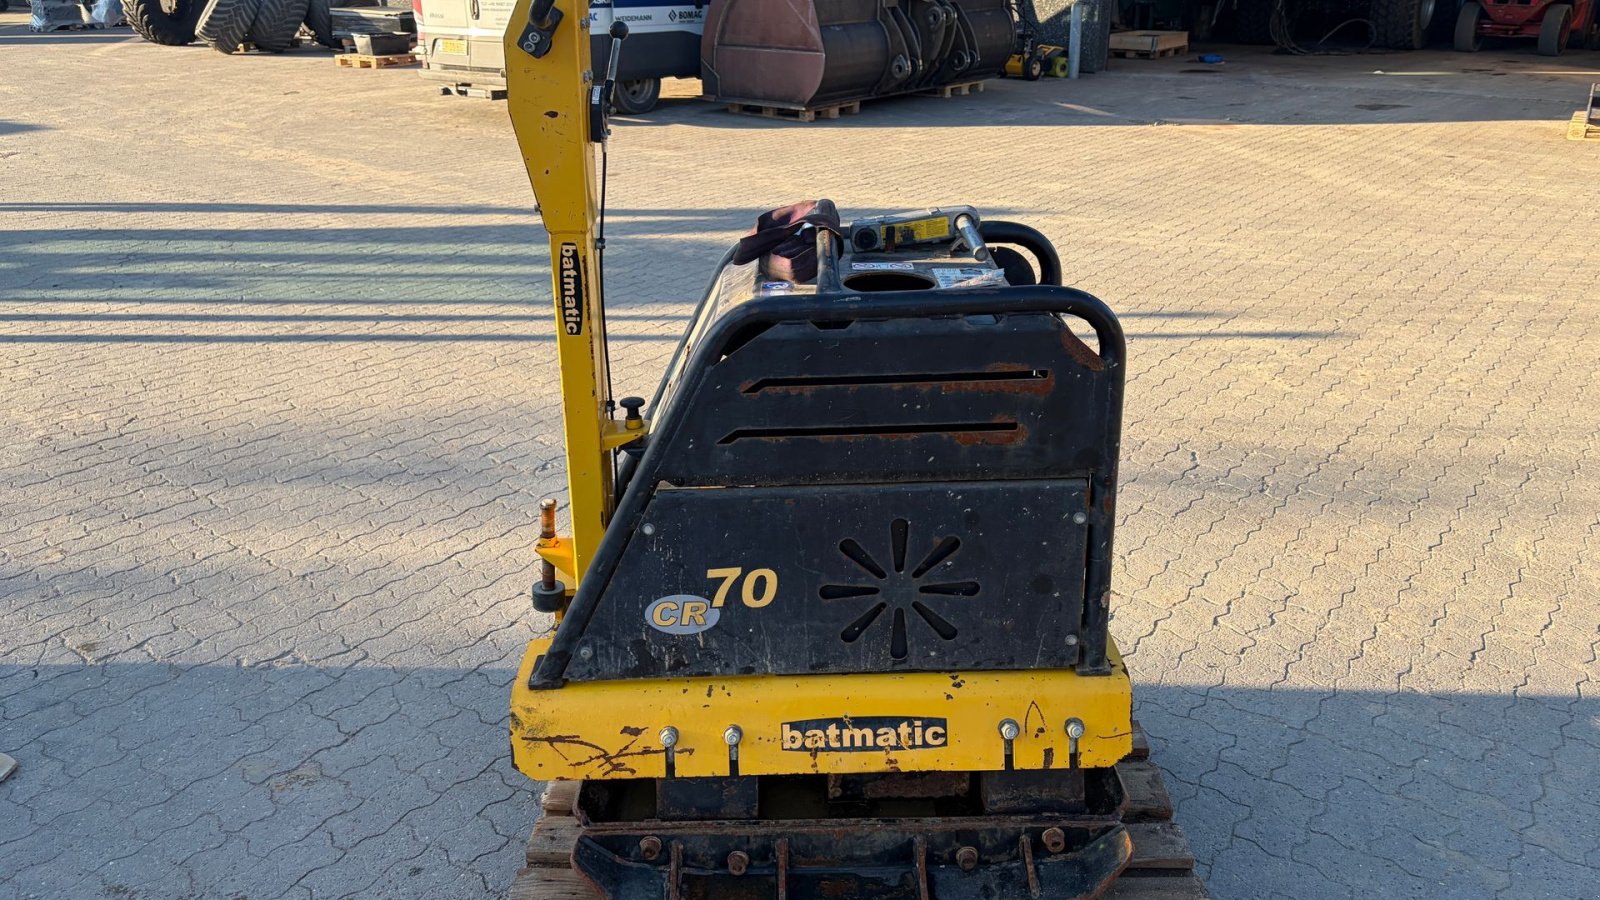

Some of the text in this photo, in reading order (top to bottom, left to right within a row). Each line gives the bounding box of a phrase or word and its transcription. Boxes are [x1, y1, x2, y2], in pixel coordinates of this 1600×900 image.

[561, 245, 580, 334] batmatic
[651, 567, 778, 626] CR 70
[781, 720, 947, 750] batmatic
